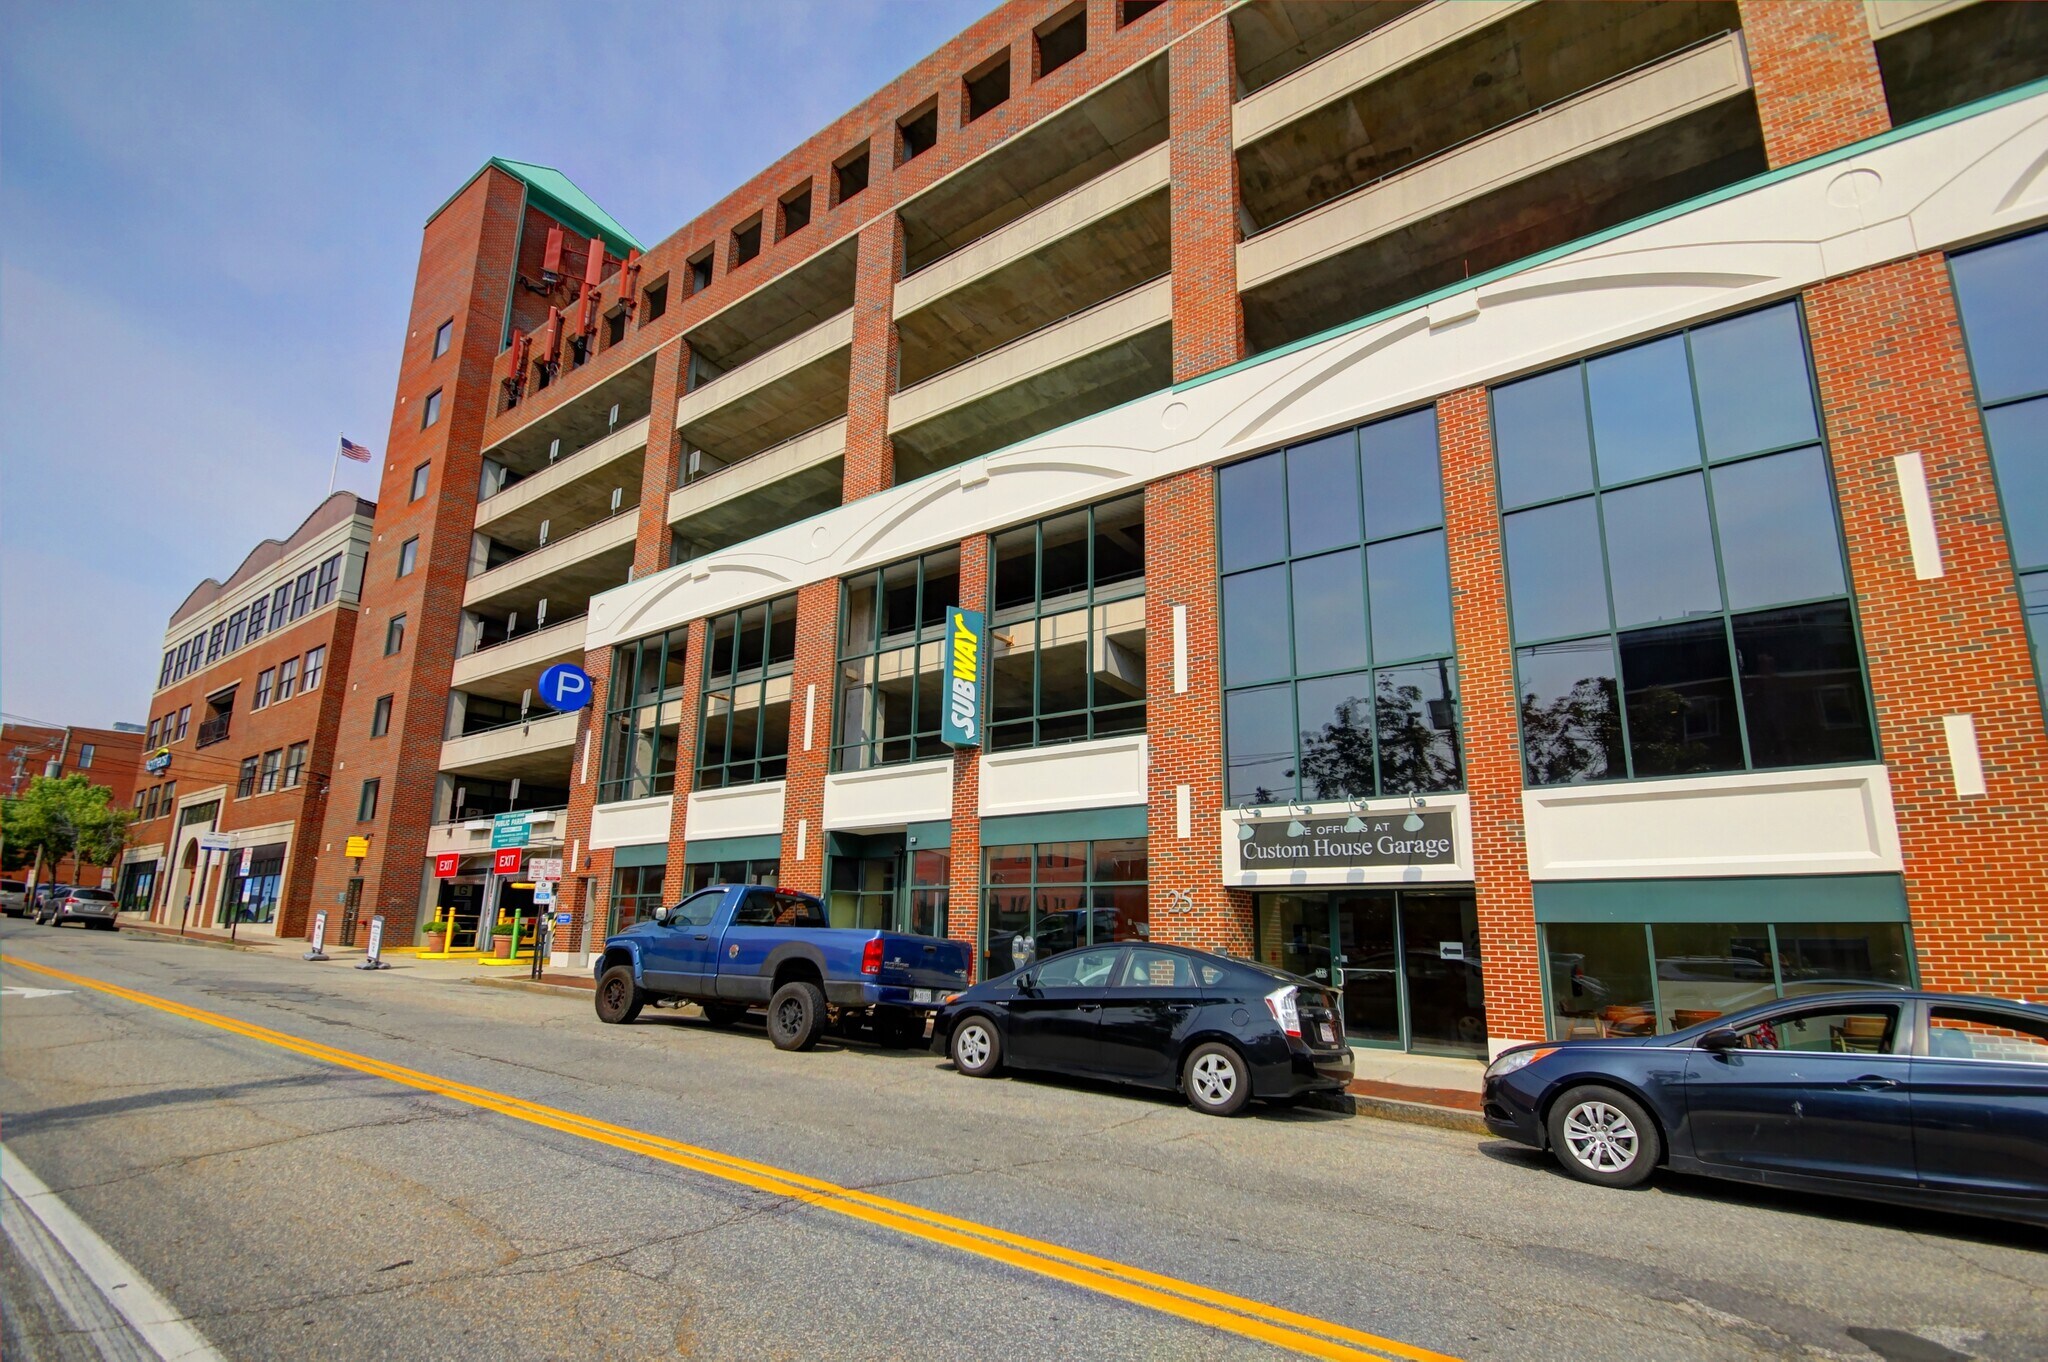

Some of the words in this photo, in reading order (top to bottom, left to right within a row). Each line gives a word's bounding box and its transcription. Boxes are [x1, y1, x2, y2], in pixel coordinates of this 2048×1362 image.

[951, 613, 977, 739] SUBWAY
[556, 671, 585, 702] P
[1374, 822, 1390, 832] AT
[1243, 842, 1310, 860] Custom
[1313, 839, 1373, 856] House
[1377, 836, 1450, 858] Garage
[439, 859, 454, 871] EXIT
[499, 854, 516, 867] EXIT
[460, 885, 469, 895] G
[1168, 889, 1193, 913] 25
